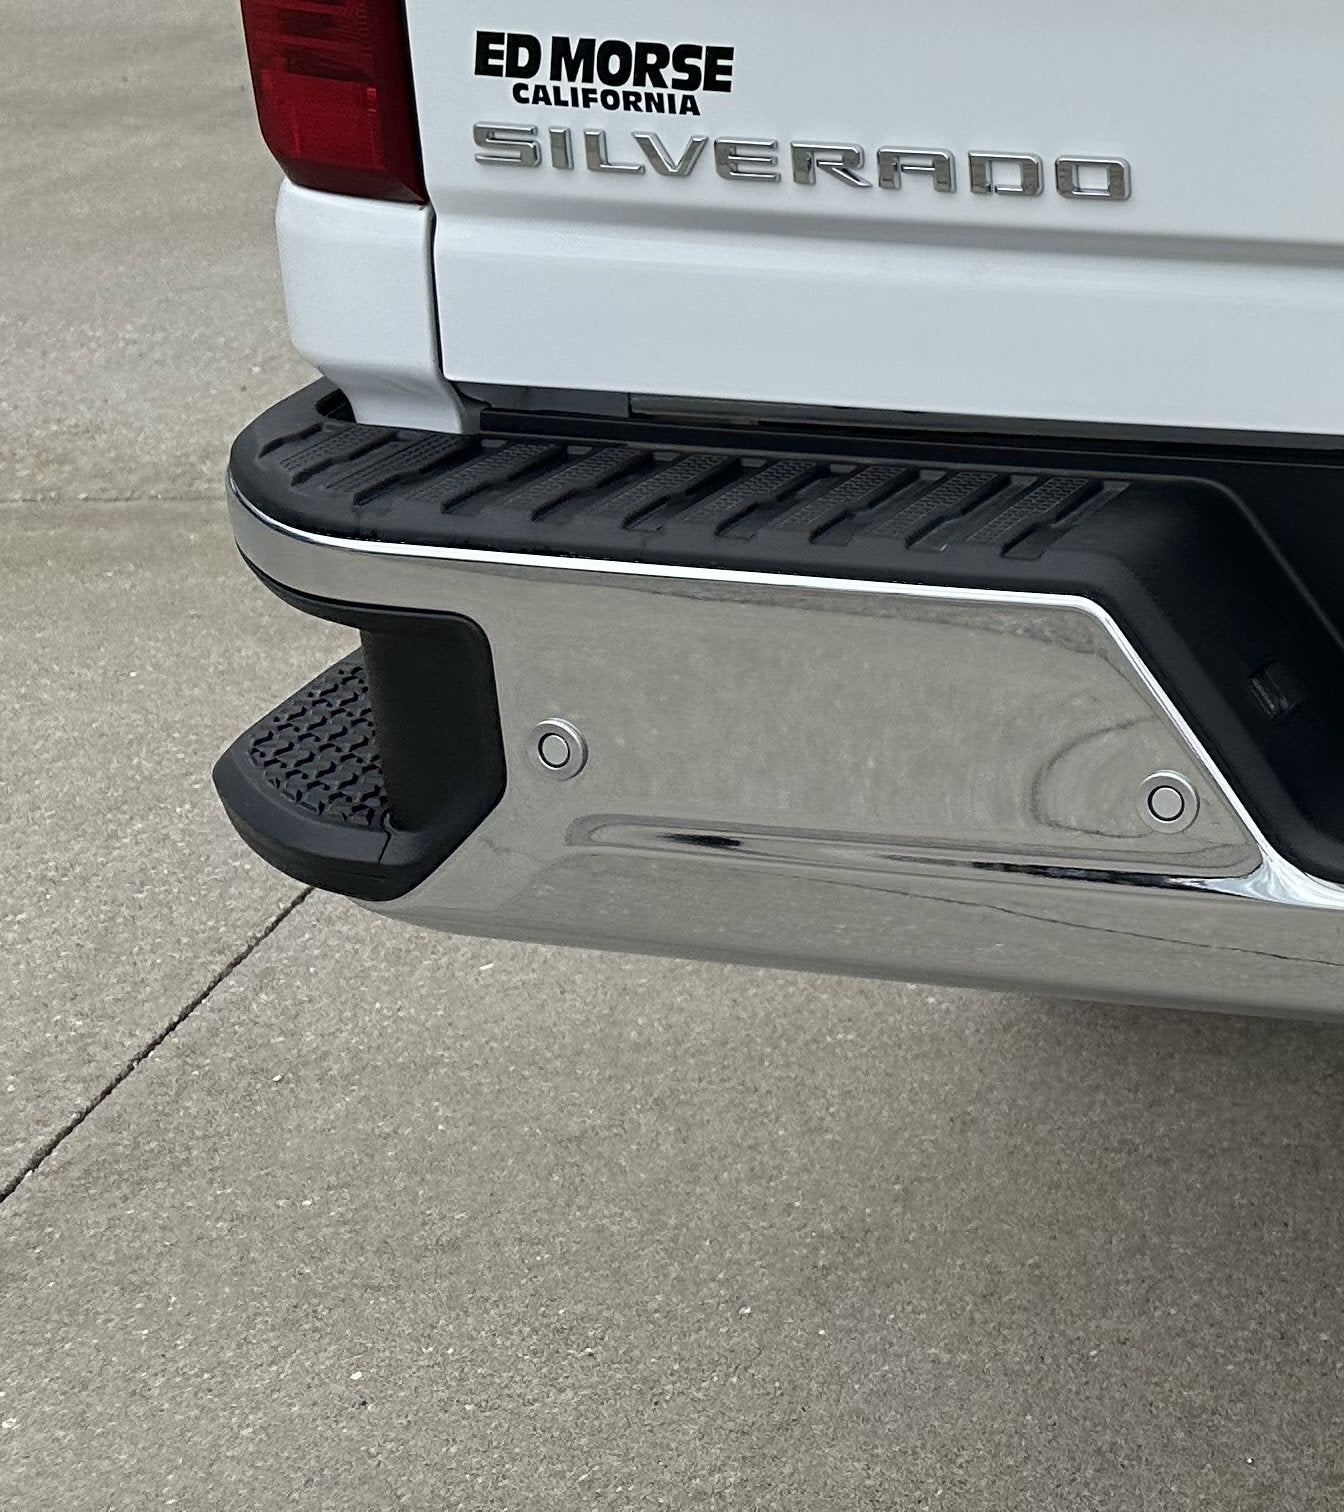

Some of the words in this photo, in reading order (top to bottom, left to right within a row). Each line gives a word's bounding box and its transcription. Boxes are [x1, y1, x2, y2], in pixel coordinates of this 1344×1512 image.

[474, 31, 542, 79] ED
[551, 36, 734, 92] MORSE
[512, 84, 701, 116] CALIFORNIA
[473, 122, 1131, 200] SILVERADO
